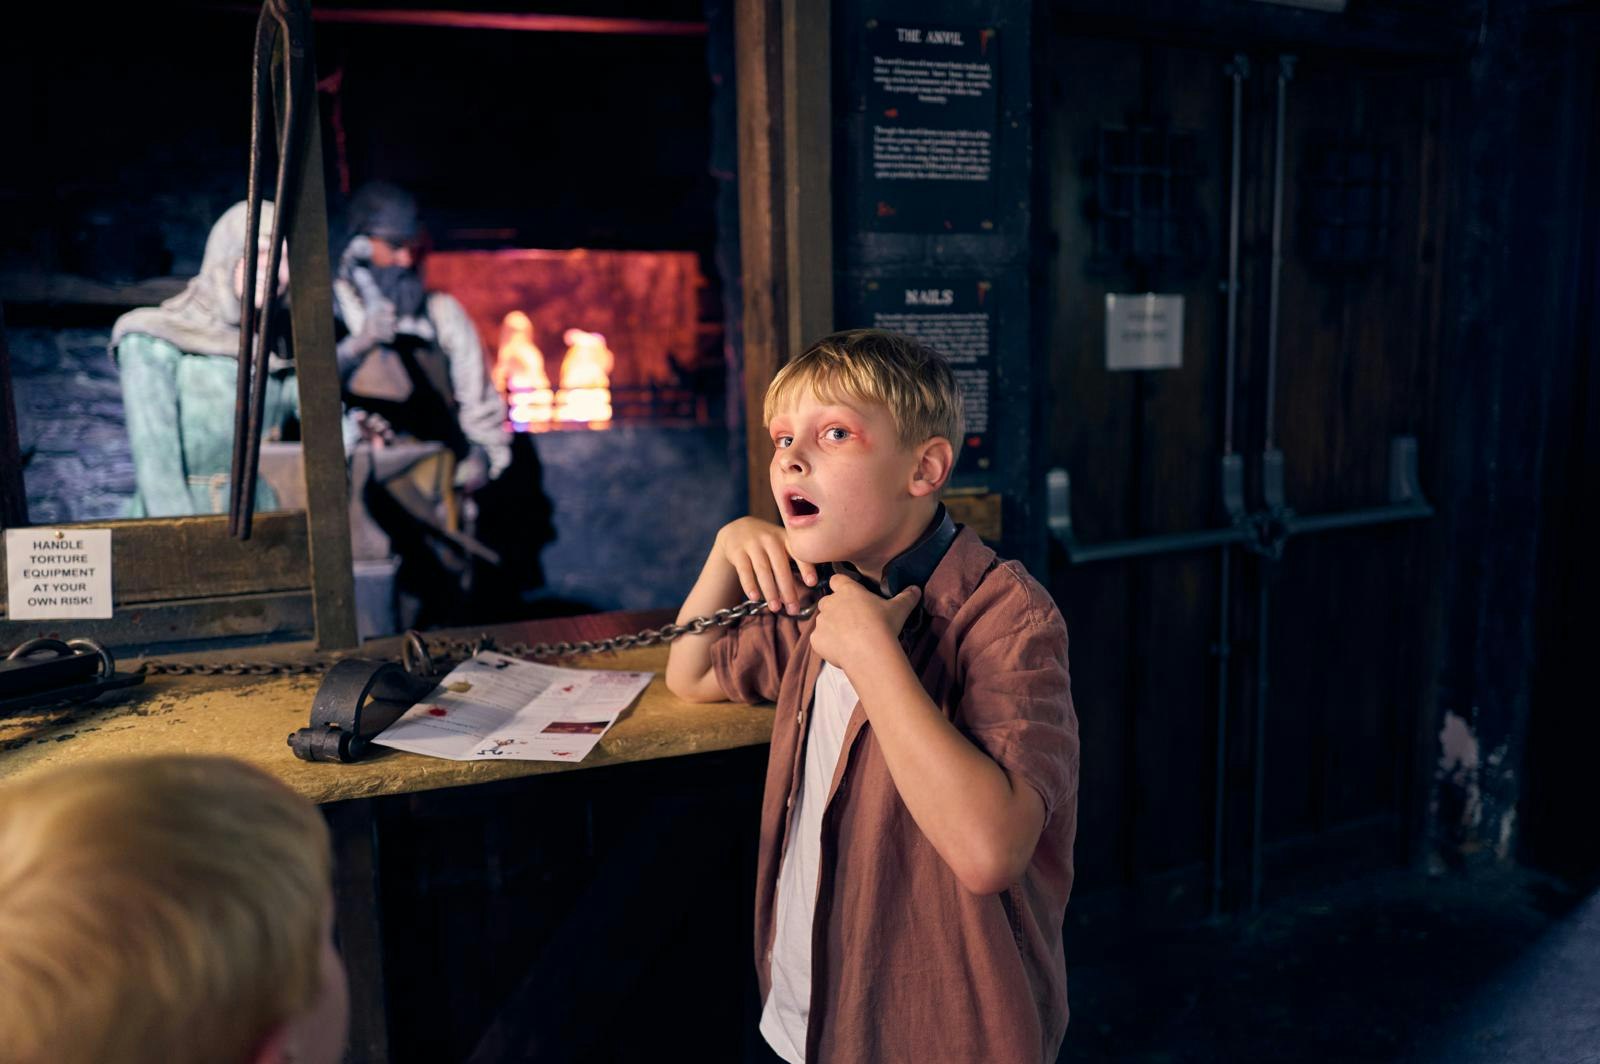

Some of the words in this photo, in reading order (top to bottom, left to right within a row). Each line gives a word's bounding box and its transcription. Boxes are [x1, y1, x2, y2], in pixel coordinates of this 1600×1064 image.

[897, 28, 922, 43] THE
[925, 30, 964, 46] ANVIL
[904, 288, 954, 306] NAILS
[33, 540, 84, 550] HANDLE
[30, 554, 89, 564] TORTURE
[23, 568, 96, 578] EQUIPMENT
[33, 584, 48, 592] AT
[52, 583, 87, 592] YOUR
[28, 597, 57, 606] OWN
[61, 596, 93, 606] RISK!
